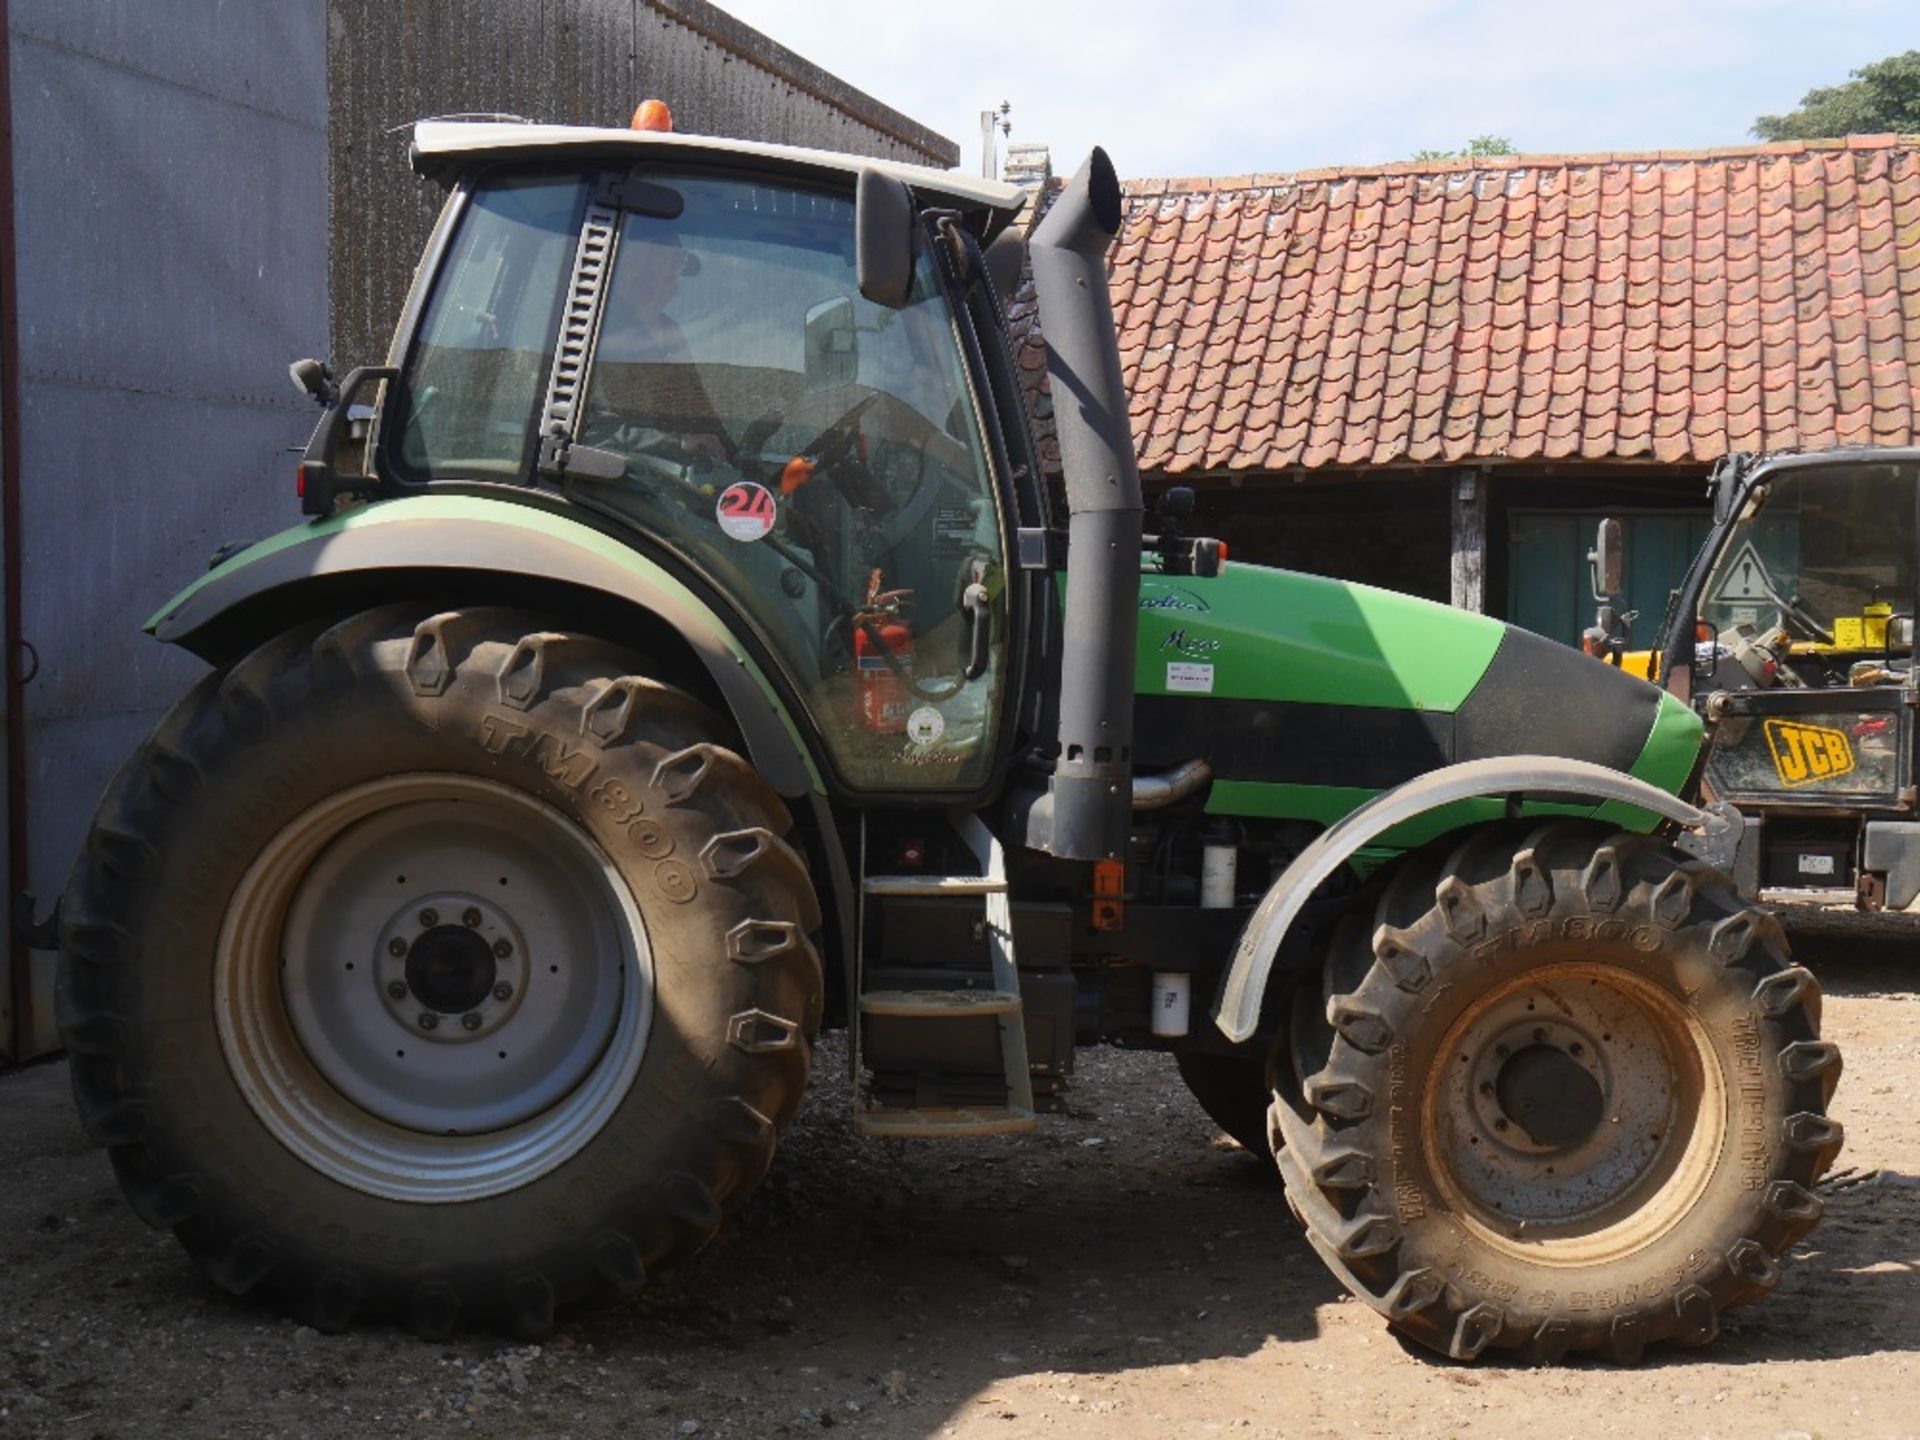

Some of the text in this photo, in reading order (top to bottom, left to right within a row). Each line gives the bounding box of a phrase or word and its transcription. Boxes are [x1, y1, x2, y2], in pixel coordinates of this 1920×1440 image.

[723, 485, 774, 529] 24
[1778, 726, 1849, 781] JCB
[481, 714, 698, 905] TM800
[1473, 915, 1664, 963] TM800
